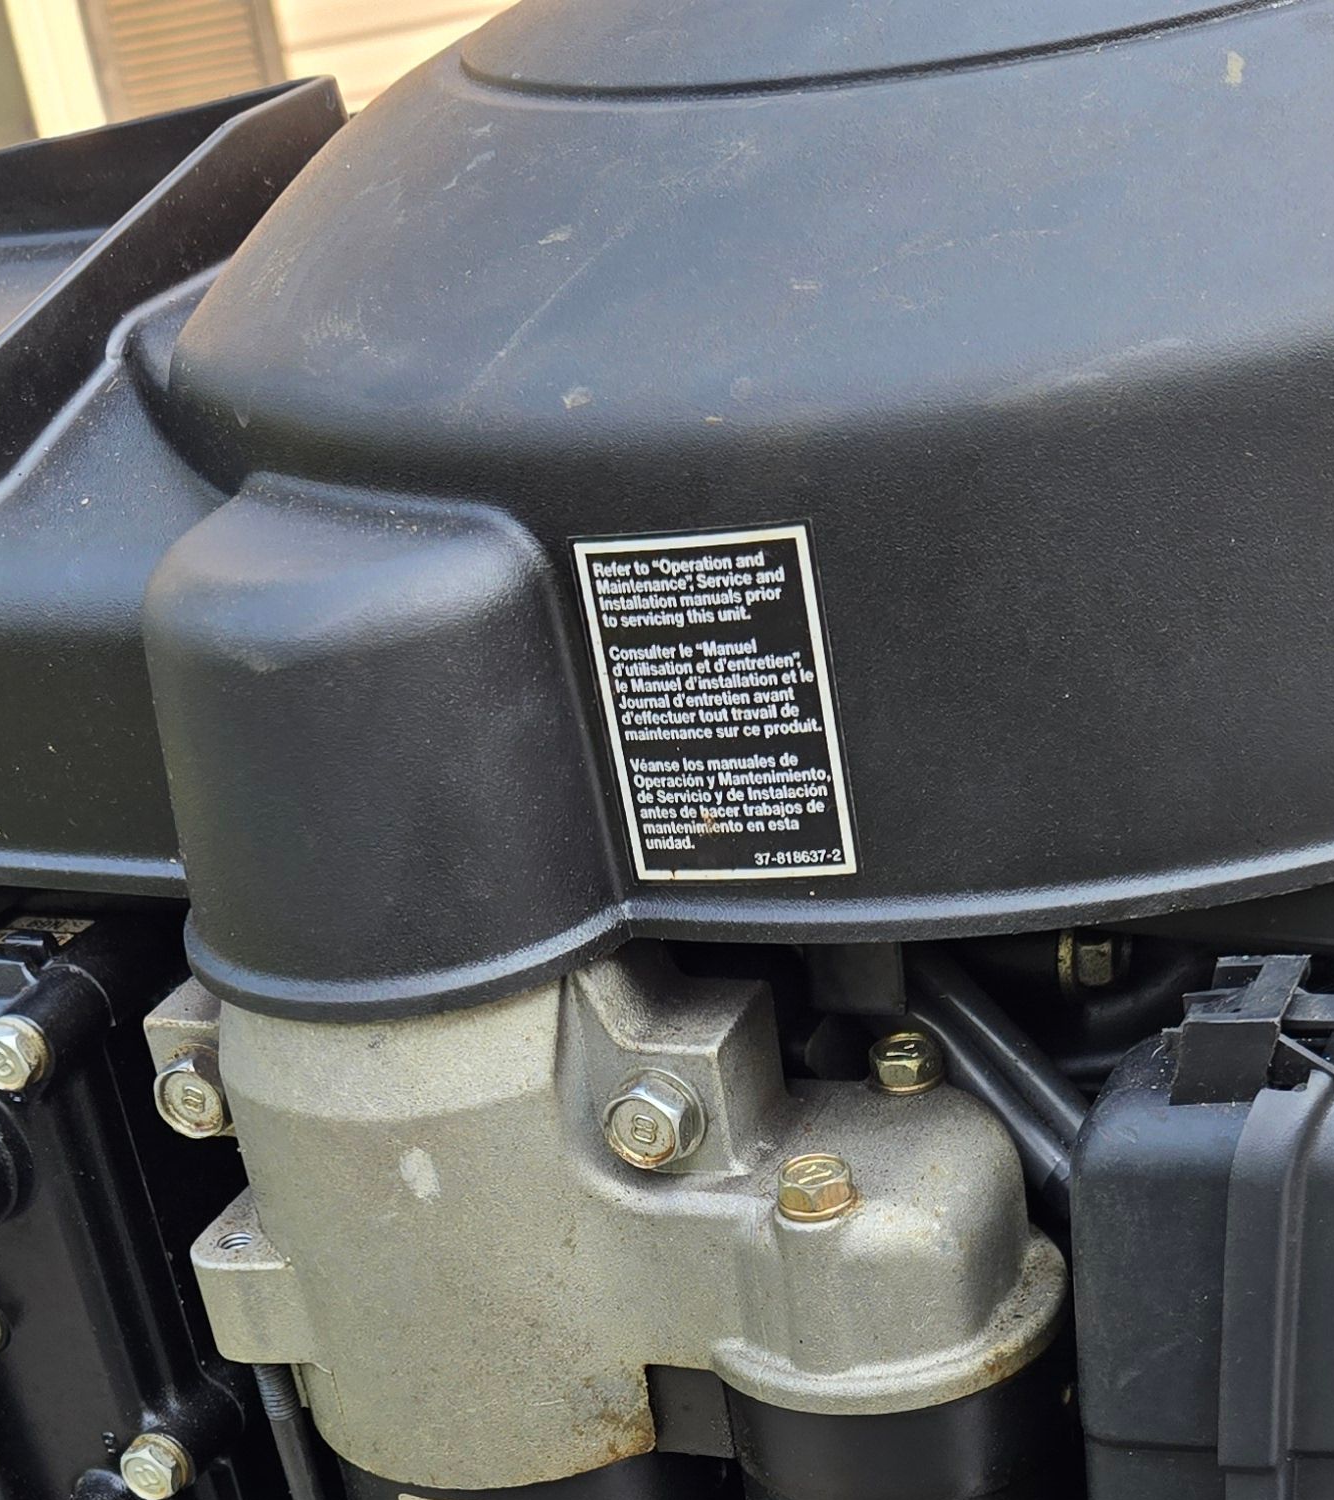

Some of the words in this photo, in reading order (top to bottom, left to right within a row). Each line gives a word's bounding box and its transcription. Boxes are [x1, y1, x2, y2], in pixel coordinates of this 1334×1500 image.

[592, 561, 631, 577] Refer
[633, 560, 650, 576] to
[735, 549, 765, 569] and
[696, 571, 753, 589] Service
[755, 564, 785, 584] and
[598, 594, 677, 611] Installation
[680, 588, 742, 607] manuals
[745, 586, 781, 606] prior
[602, 613, 618, 628] to
[620, 610, 684, 628] servicing
[687, 608, 715, 624] this
[717, 605, 751, 622] unit.
[609, 644, 676, 660] Consulter
[679, 642, 693, 658] le
[612, 660, 693, 677] d'utilisation
[695, 659, 712, 674] et
[614, 678, 628, 693] le
[630, 676, 682, 692] Manuel
[685, 672, 778, 690] d'installation
[781, 669, 798, 684] et
[799, 668, 814, 683] le
[618, 693, 670, 709] Journal
[673, 690, 750, 708] d'entretien
[753, 686, 795, 703] avant
[621, 710, 696, 725] d'effectuer
[698, 708, 728, 723] tout
[731, 704, 778, 721] travail
[780, 702, 800, 717] de
[625, 726, 712, 741] maintenance
[716, 726, 739, 738] sur
[742, 724, 760, 737] ce
[763, 718, 822, 739] produit.
[629, 758, 680, 772] Véanse
[682, 757, 705, 771] los
[706, 754, 776, 771] manuales
[779, 752, 798, 767] de
[633, 773, 704, 790] Operación
[706, 775, 715, 789] y
[718, 767, 831, 786] Mantenimiento,
[637, 789, 654, 803] de
[656, 789, 711, 803] Servicio
[714, 791, 723, 805] y
[726, 787, 745, 801] de
[747, 783, 828, 801] Instalación
[640, 806, 677, 819] antes
[680, 805, 697, 819] de
[699, 805, 740, 818] hacer
[742, 802, 803, 818] trabajos
[806, 799, 825, 813] de
[746, 821, 765, 832] en
[768, 817, 799, 831] esta
[645, 835, 695, 850] unidad.
[754, 848, 842, 865] 37-818637-2
[631, 1113, 658, 1144] 8
